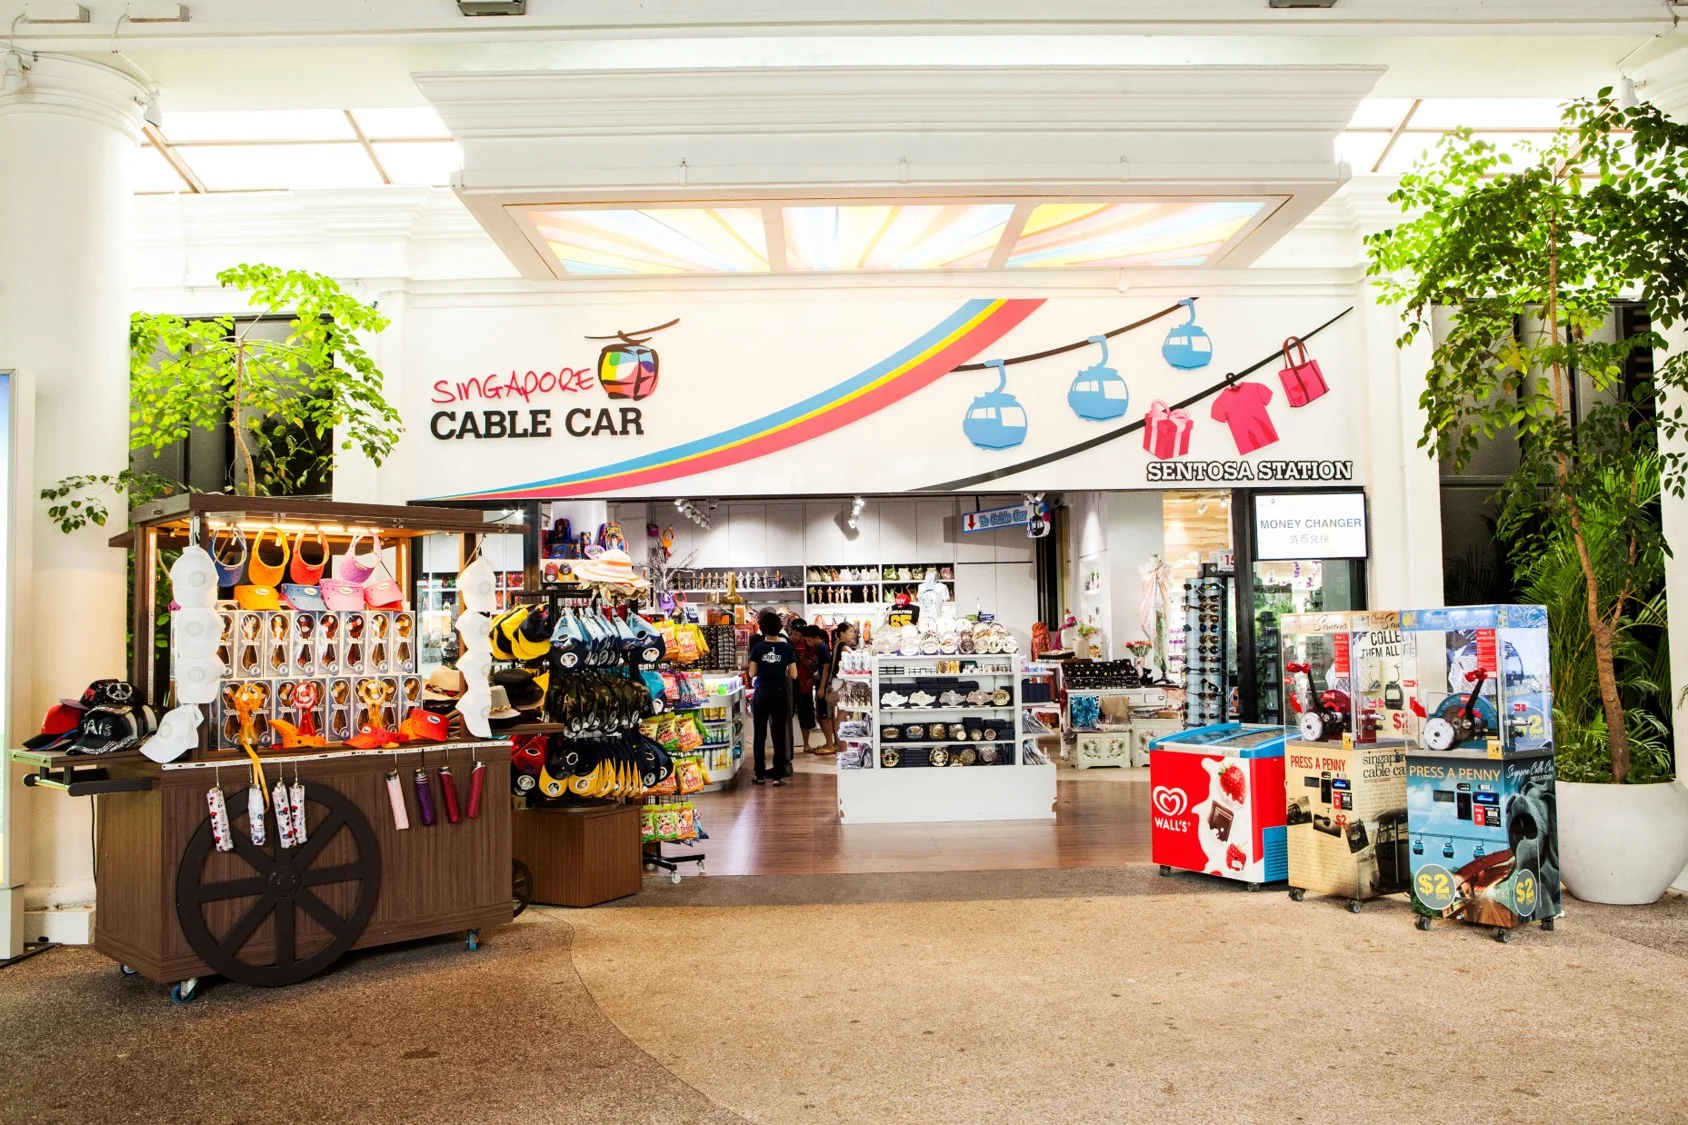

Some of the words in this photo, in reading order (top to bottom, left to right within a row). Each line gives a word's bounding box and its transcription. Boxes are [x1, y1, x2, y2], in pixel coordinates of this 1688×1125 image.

[430, 367, 595, 404] SINGAPORE
[430, 408, 551, 441] CABLE
[565, 407, 644, 437] CAR
[1146, 460, 1254, 481] SENTOSA
[1257, 460, 1353, 480] STATION
[978, 514, 989, 527] To
[990, 511, 1012, 525] Cable
[1013, 509, 1028, 522] Car
[1260, 519, 1301, 529] MONEY
[1305, 518, 1362, 528] CHANGER
[1370, 630, 1411, 646] COLLE
[762, 654, 782, 662] CREW
[1385, 645, 1400, 657] ALL
[1290, 755, 1313, 769] PRESS
[1315, 758, 1321, 769] A
[1322, 758, 1346, 772] PENNY
[1362, 752, 1406, 767] singapr
[1363, 764, 1390, 779] cable
[1393, 766, 1406, 777] ca
[1409, 765, 1444, 779] PRESS
[1447, 767, 1456, 779] A
[1458, 768, 1501, 782] PENNY
[1154, 817, 1188, 833] WALL'S
[1418, 873, 1450, 896] $2
[1515, 877, 1534, 904] $2
